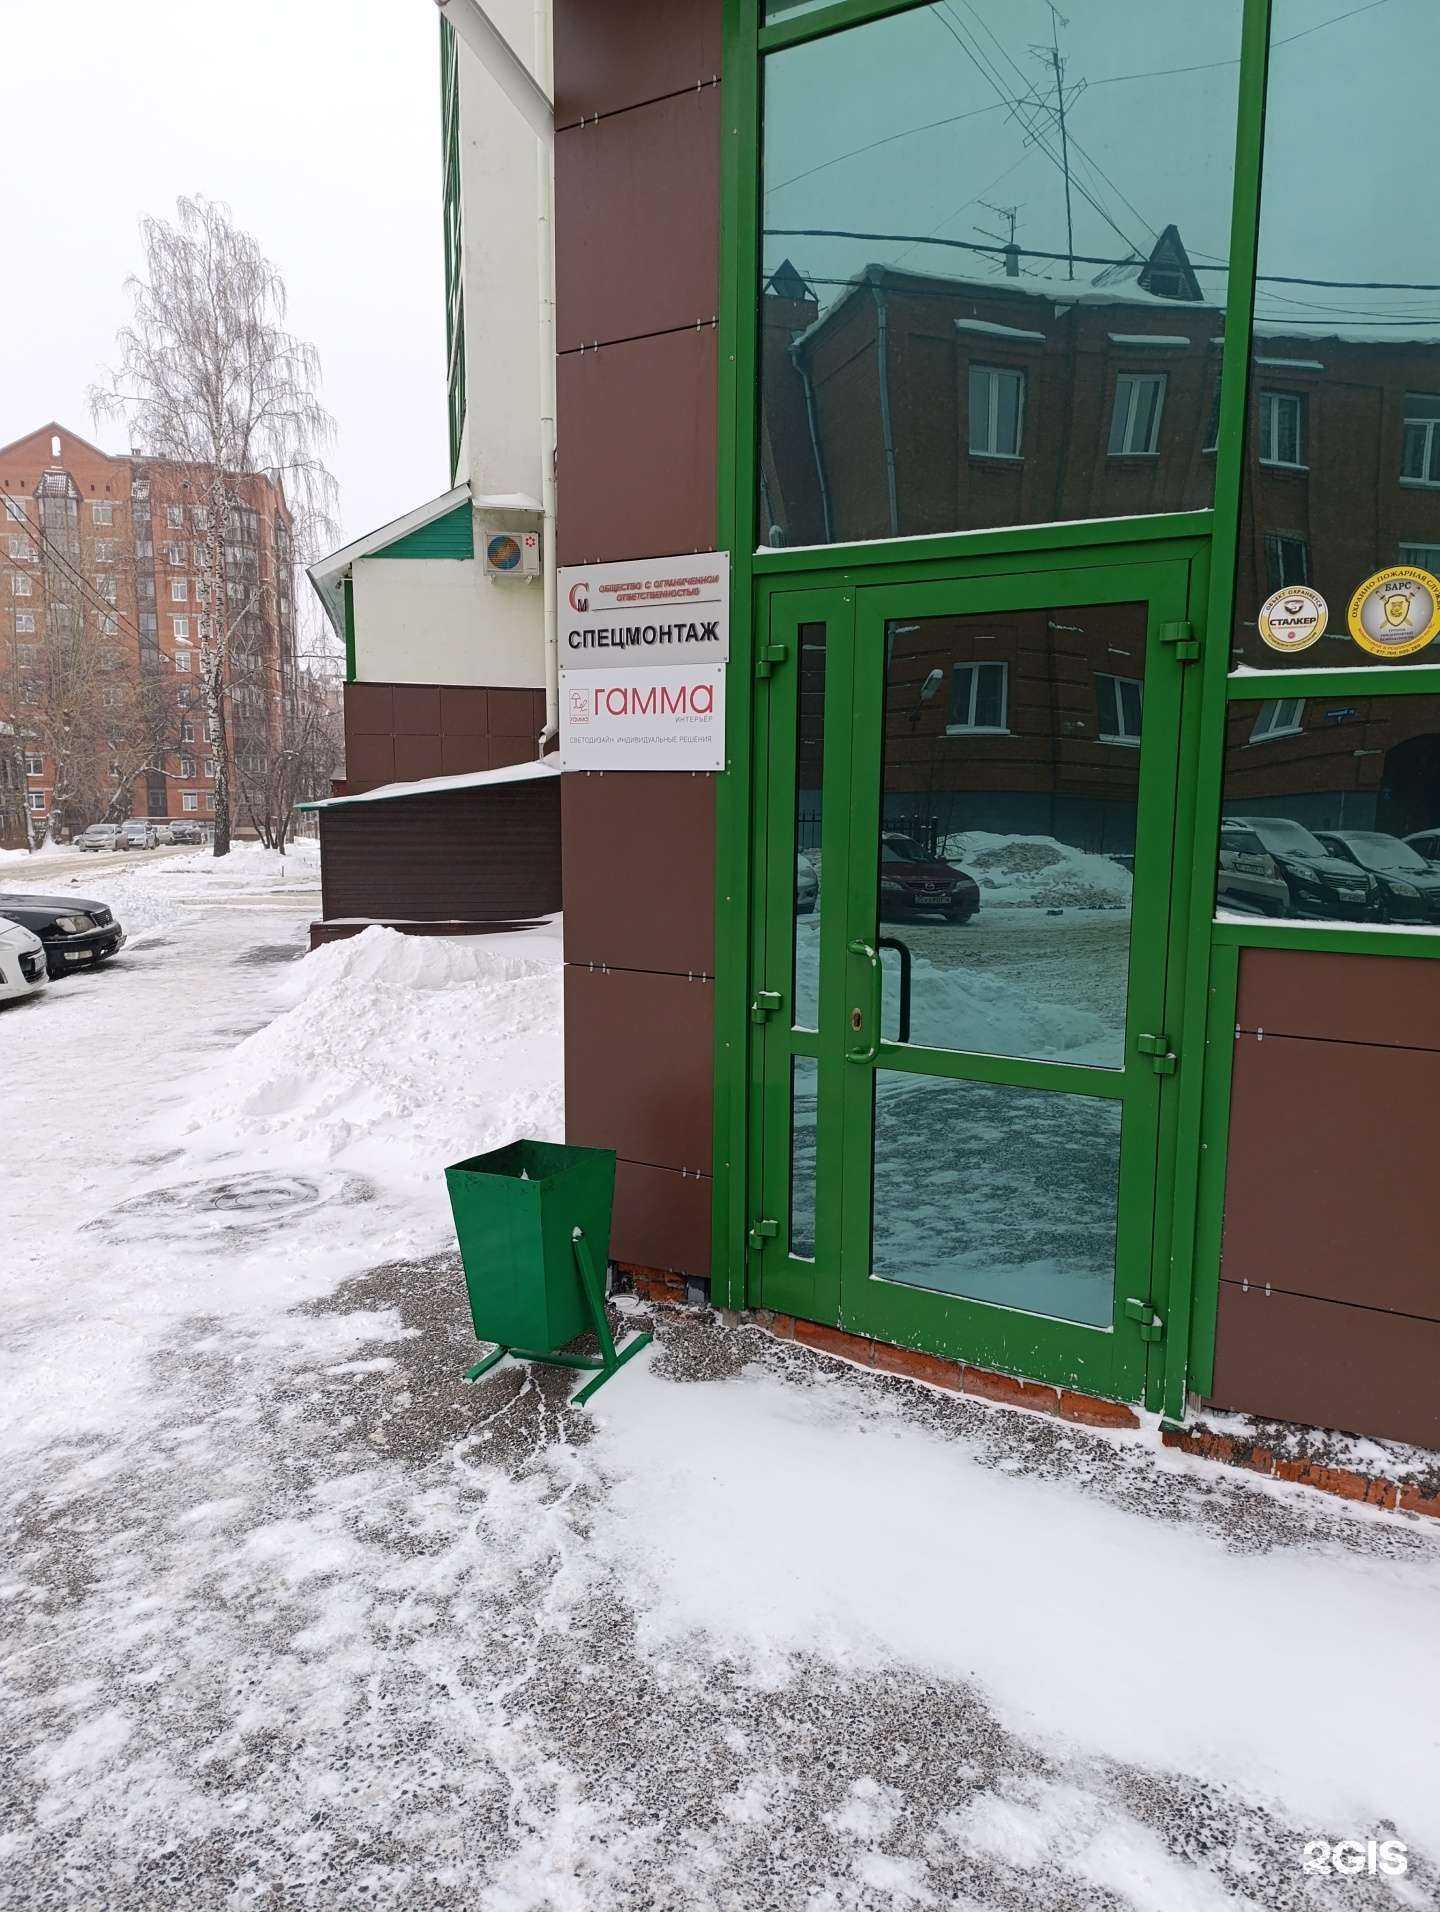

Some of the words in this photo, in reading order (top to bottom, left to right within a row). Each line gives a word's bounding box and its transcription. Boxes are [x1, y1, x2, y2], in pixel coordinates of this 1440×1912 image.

[599, 582, 642, 593] ОБЩЕСТВО
[644, 580, 653, 589] С
[653, 574, 720, 588] ОГРАНИЧЕННОЙ
[1385, 582, 1412, 592] БАРС
[616, 587, 700, 602] ОТВЕТСТВЕННОСТЬЮ
[1270, 617, 1317, 626] СТАЛКЕР
[568, 621, 720, 649] СПЕЦМОНТАЖ
[675, 715, 713, 724] ИНТЕРЬЕР
[679, 735, 713, 744] РЕШЕНИЯ
